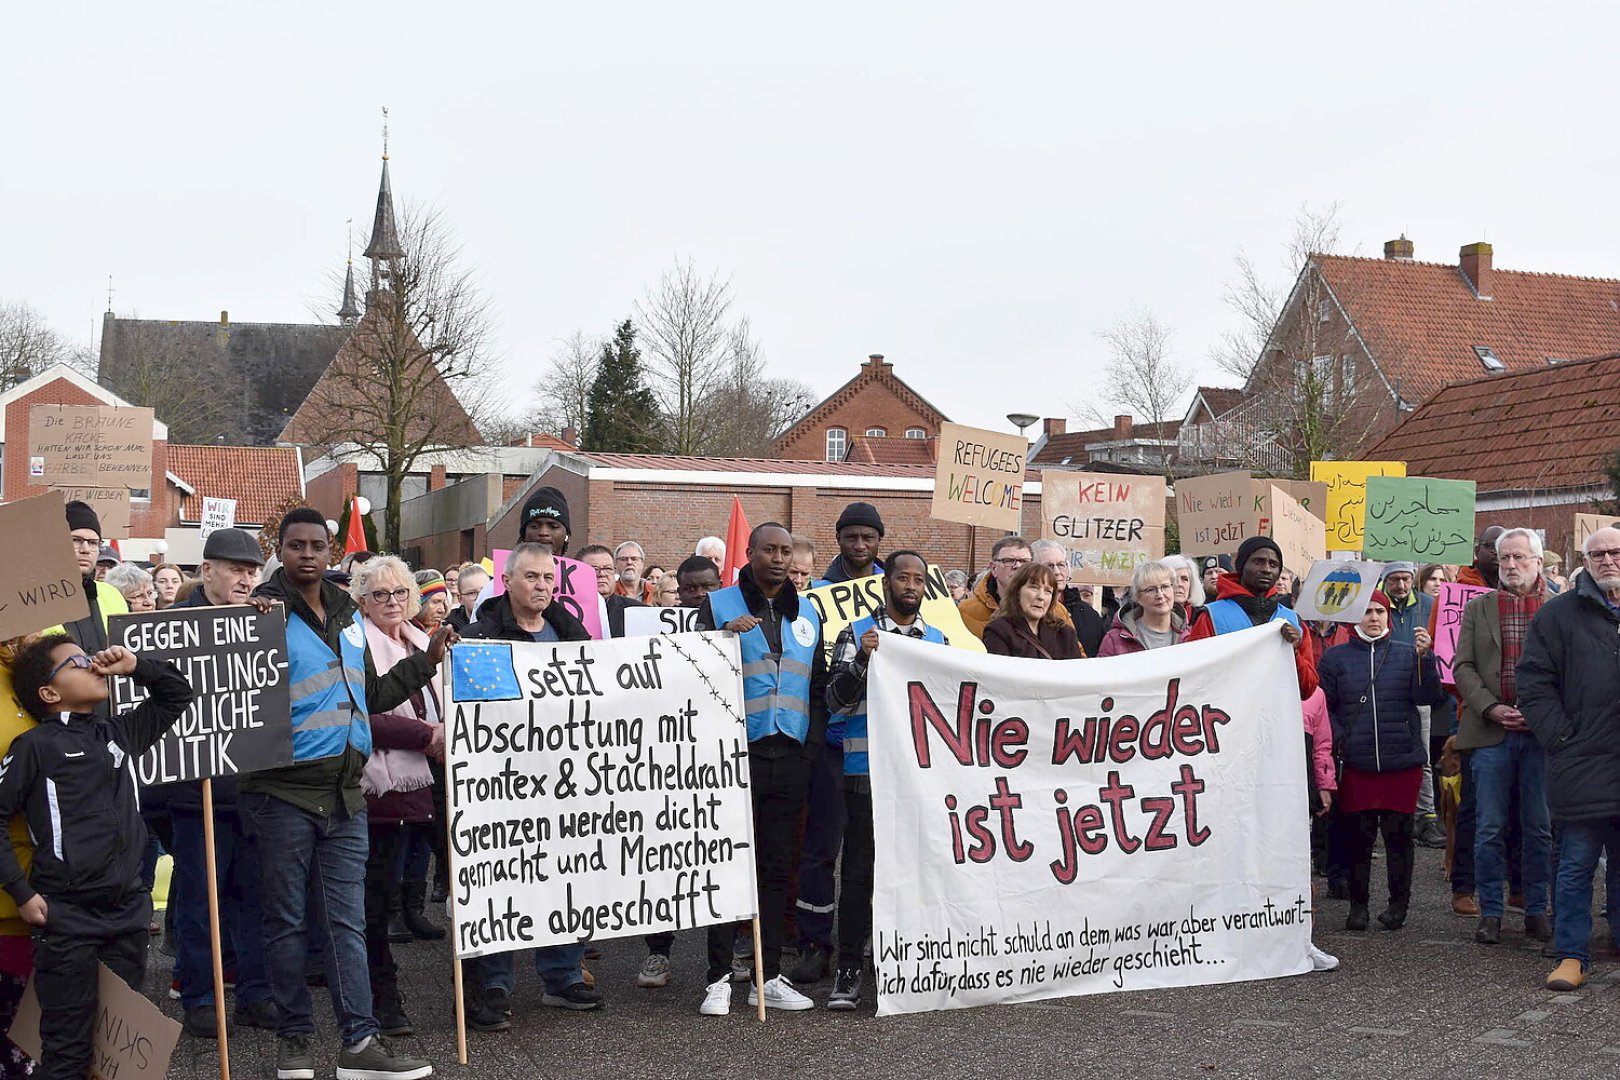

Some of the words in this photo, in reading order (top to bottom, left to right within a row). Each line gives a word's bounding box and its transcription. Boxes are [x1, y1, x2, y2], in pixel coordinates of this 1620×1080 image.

[44, 415, 65, 428] Die
[65, 432, 107, 444] KACKE
[75, 444, 92, 452] WIR
[94, 444, 122, 452] SCHON
[954, 440, 1022, 474] REFUGEES
[98, 462, 150, 473] BEKENNEN
[85, 489, 124, 501] WIEDER
[207, 501, 230, 514] WIR
[948, 472, 1022, 511] WELCOME
[1078, 480, 1131, 504] KEIN
[1182, 491, 1203, 514] Nie
[209, 513, 227, 521] SIND
[1053, 515, 1145, 542] GLITZER
[1195, 526, 1210, 543] ist
[18, 579, 77, 606] WIRD
[123, 620, 200, 653] GEGEN
[213, 615, 260, 646] EINE
[527, 645, 604, 699] setzt
[616, 637, 663, 690] auf
[450, 699, 643, 763] Abschottung
[658, 699, 698, 743] mit
[907, 680, 1029, 769] Nie
[1051, 678, 1230, 765] wieder
[139, 732, 239, 785] OLITIK
[451, 757, 547, 807] Frontex
[554, 757, 577, 799] &
[584, 738, 749, 796] Stacheldraht
[451, 809, 551, 857] Grenzen
[559, 801, 644, 838] werden
[655, 793, 722, 831] dicht
[944, 776, 1035, 865] ist
[1049, 764, 1211, 886] jetzt
[457, 843, 549, 906] gemacht
[557, 838, 607, 874] und
[621, 831, 749, 876] Menschen-
[459, 896, 534, 950] rechte
[548, 869, 722, 942] abgeschafft
[879, 930, 912, 963] Wir
[916, 927, 953, 961] sind
[957, 925, 998, 959] nicht
[1004, 920, 1053, 955] schuld
[1056, 929, 1075, 950] an
[1079, 916, 1111, 950] dem,
[1114, 923, 1142, 942] was
[1222, 894, 1313, 931] verantwort-
[996, 969, 1014, 988] es
[1020, 960, 1046, 985] nie
[1053, 948, 1110, 980] wieder
[1113, 935, 1226, 989] geschieht...
[96, 1005, 154, 1070] SKIN
